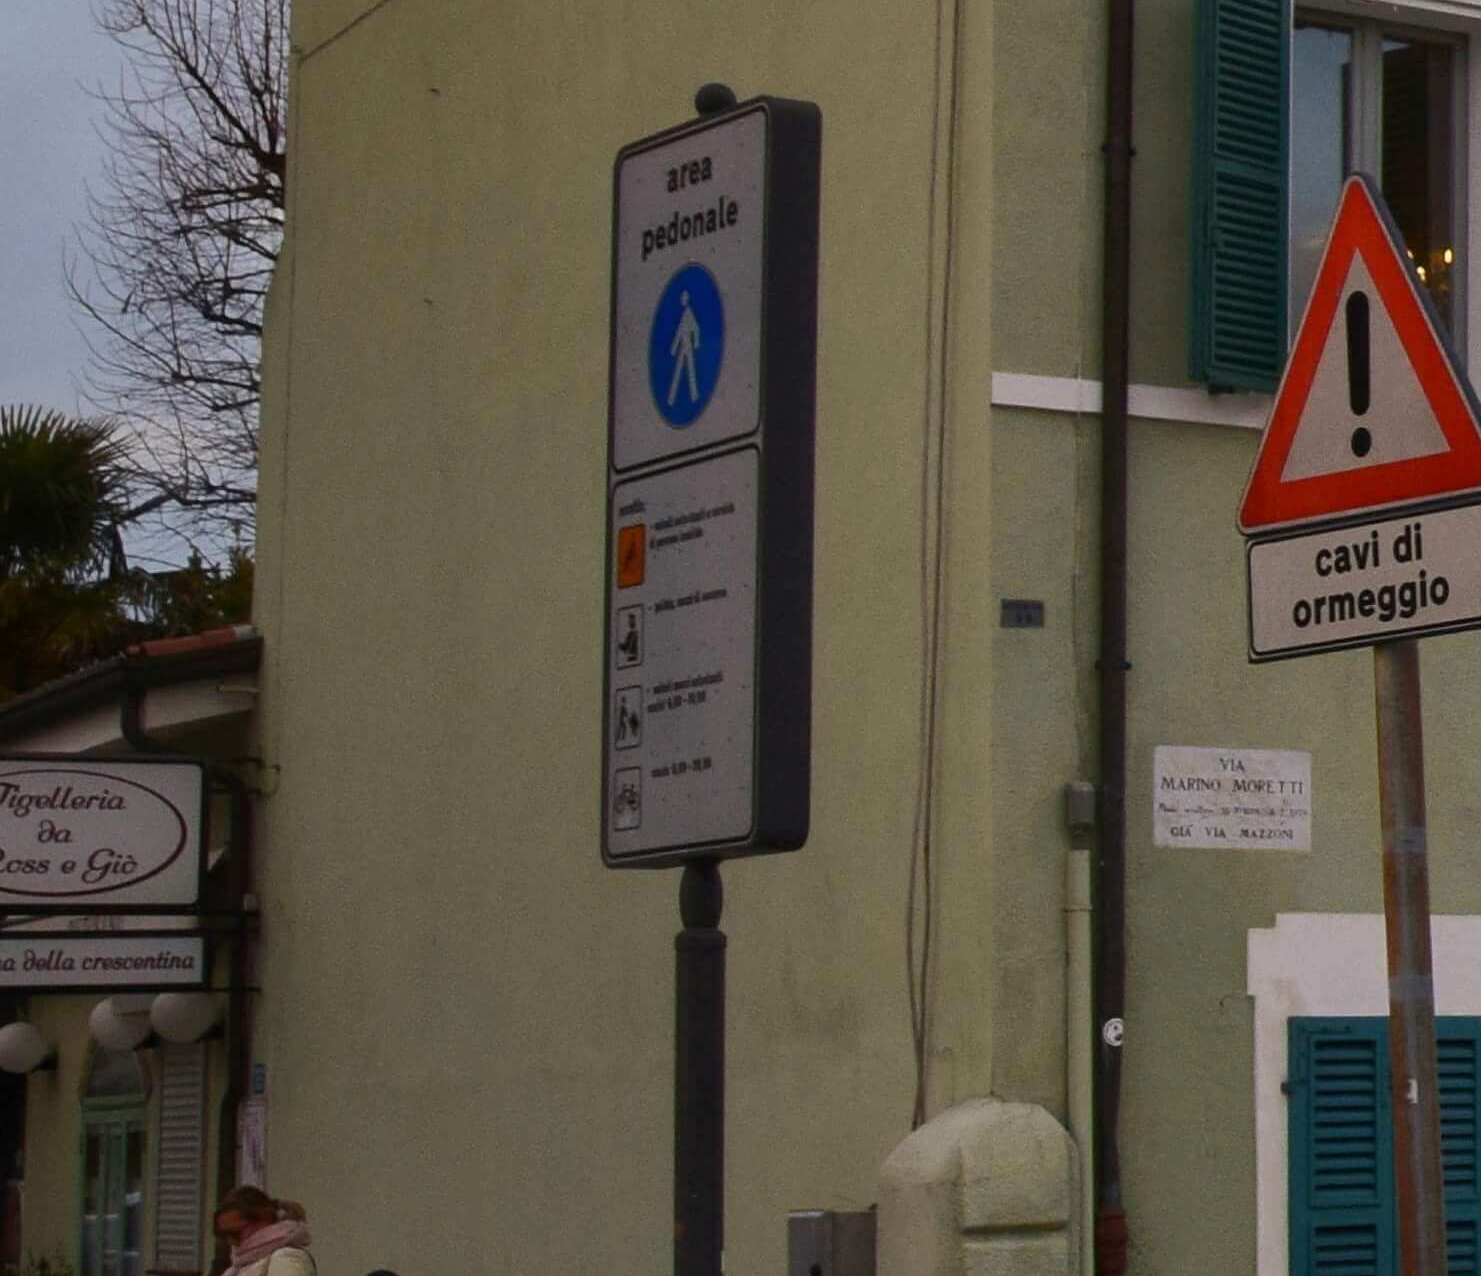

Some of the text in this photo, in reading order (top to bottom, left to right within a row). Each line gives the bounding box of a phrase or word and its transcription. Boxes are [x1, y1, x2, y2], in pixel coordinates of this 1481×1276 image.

[666, 156, 713, 193] area
[642, 196, 738, 261] pedonale
[1315, 522, 1422, 576] cavi di
[1292, 570, 1449, 628] ormeggio
[1219, 757, 1246, 773] VIA
[1160, 776, 1303, 795] MARINO MORETTI
[37, 820, 72, 843] da
[1205, 827, 1226, 838] VIA
[61, 861, 77, 874] e
[81, 848, 138, 884] Giò
[23, 949, 75, 972] della
[82, 951, 195, 972] crescentina
